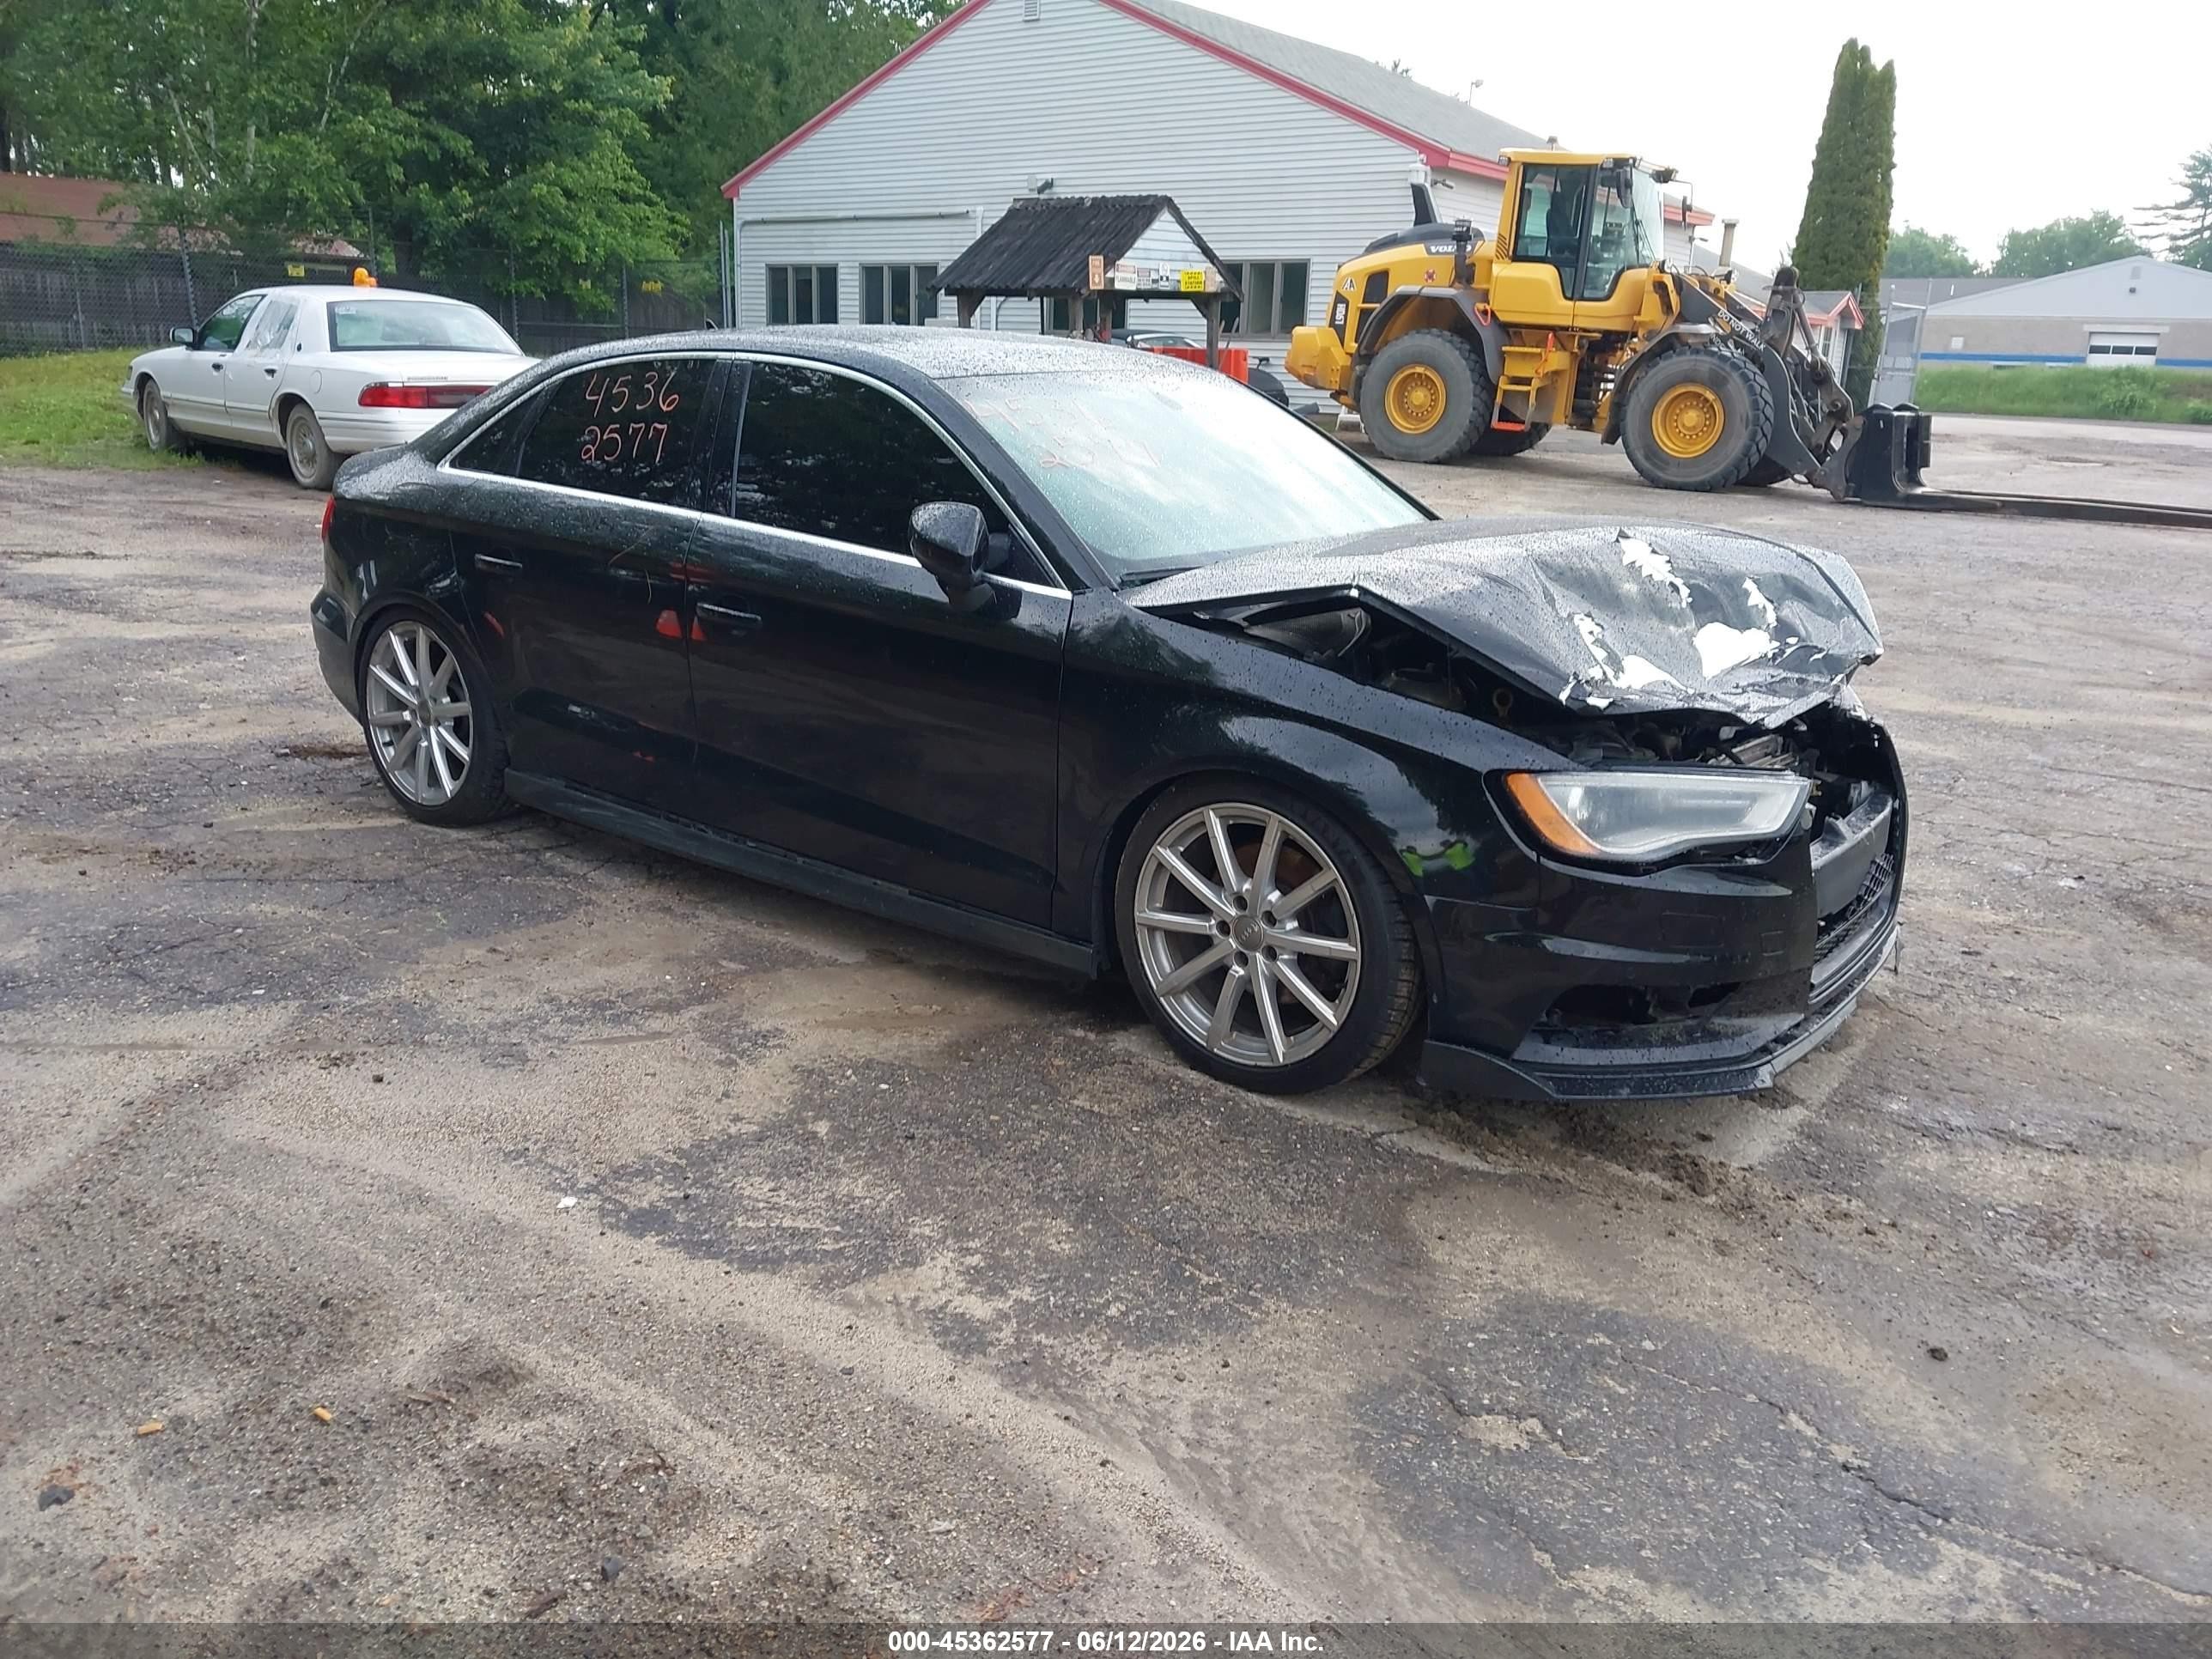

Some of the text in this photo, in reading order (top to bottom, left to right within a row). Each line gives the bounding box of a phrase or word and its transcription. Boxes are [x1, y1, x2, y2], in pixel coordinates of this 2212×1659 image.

[1717, 310, 1730, 321] DO
[1729, 320, 1747, 335] NOT
[1746, 332, 1766, 351] WALK
[586, 370, 679, 417] 4536
[581, 422, 667, 464] 2577
